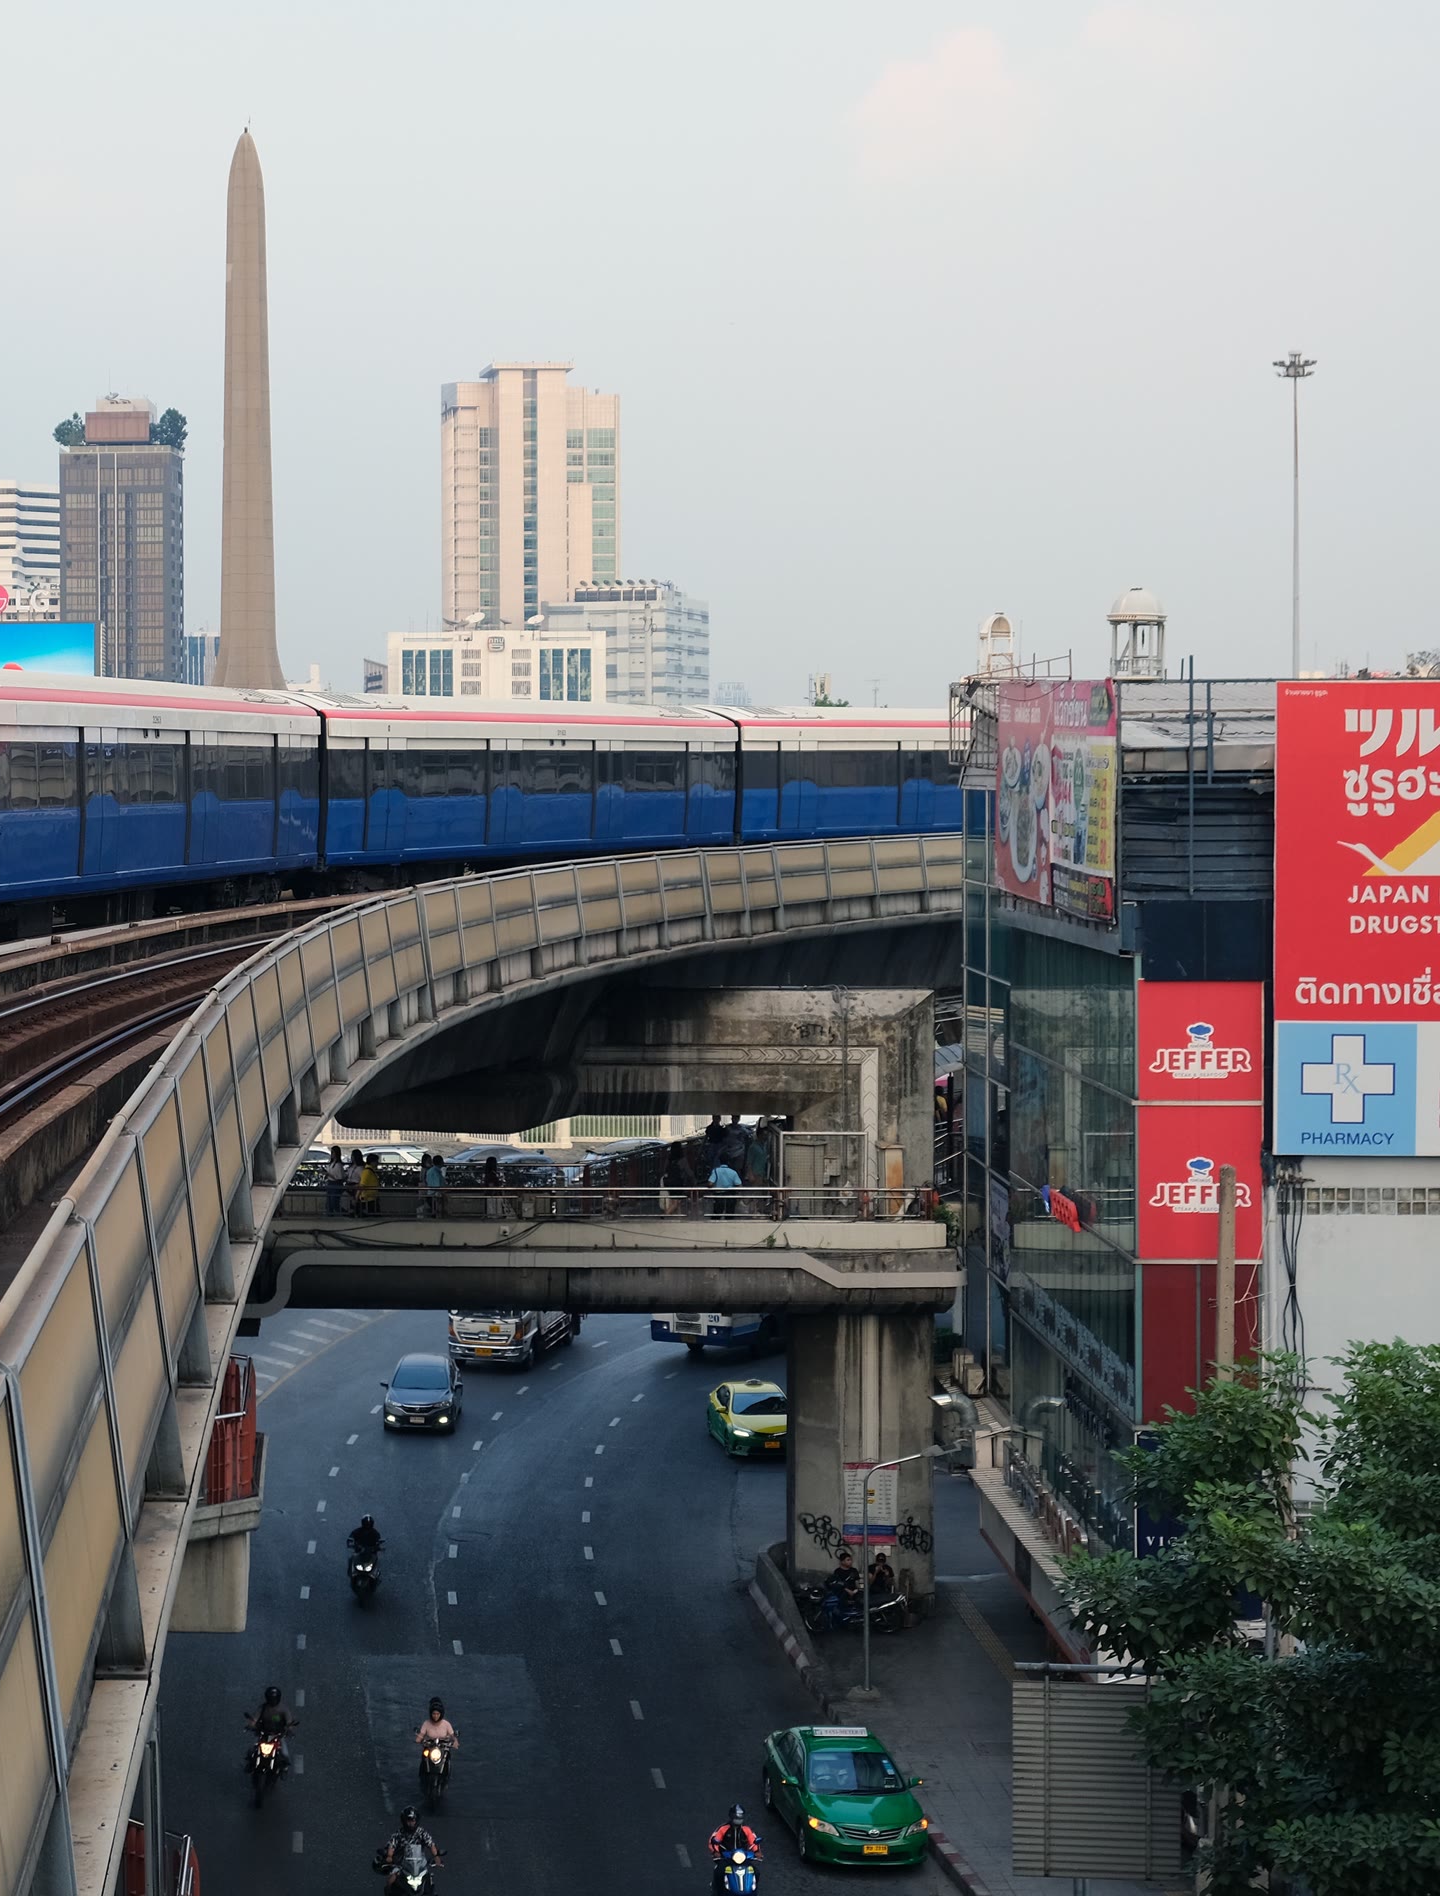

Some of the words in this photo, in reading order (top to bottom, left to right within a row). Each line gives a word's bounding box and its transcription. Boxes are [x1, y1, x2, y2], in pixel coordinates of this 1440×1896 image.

[16, 589, 50, 612] LG
[1347, 885, 1430, 904] JAPAN
[1150, 1049, 1251, 1072] JEFFER
[1301, 1132, 1395, 1145] PHARMACY
[1150, 1184, 1251, 1206] JEFFR
[708, 1314, 720, 1323] 20
